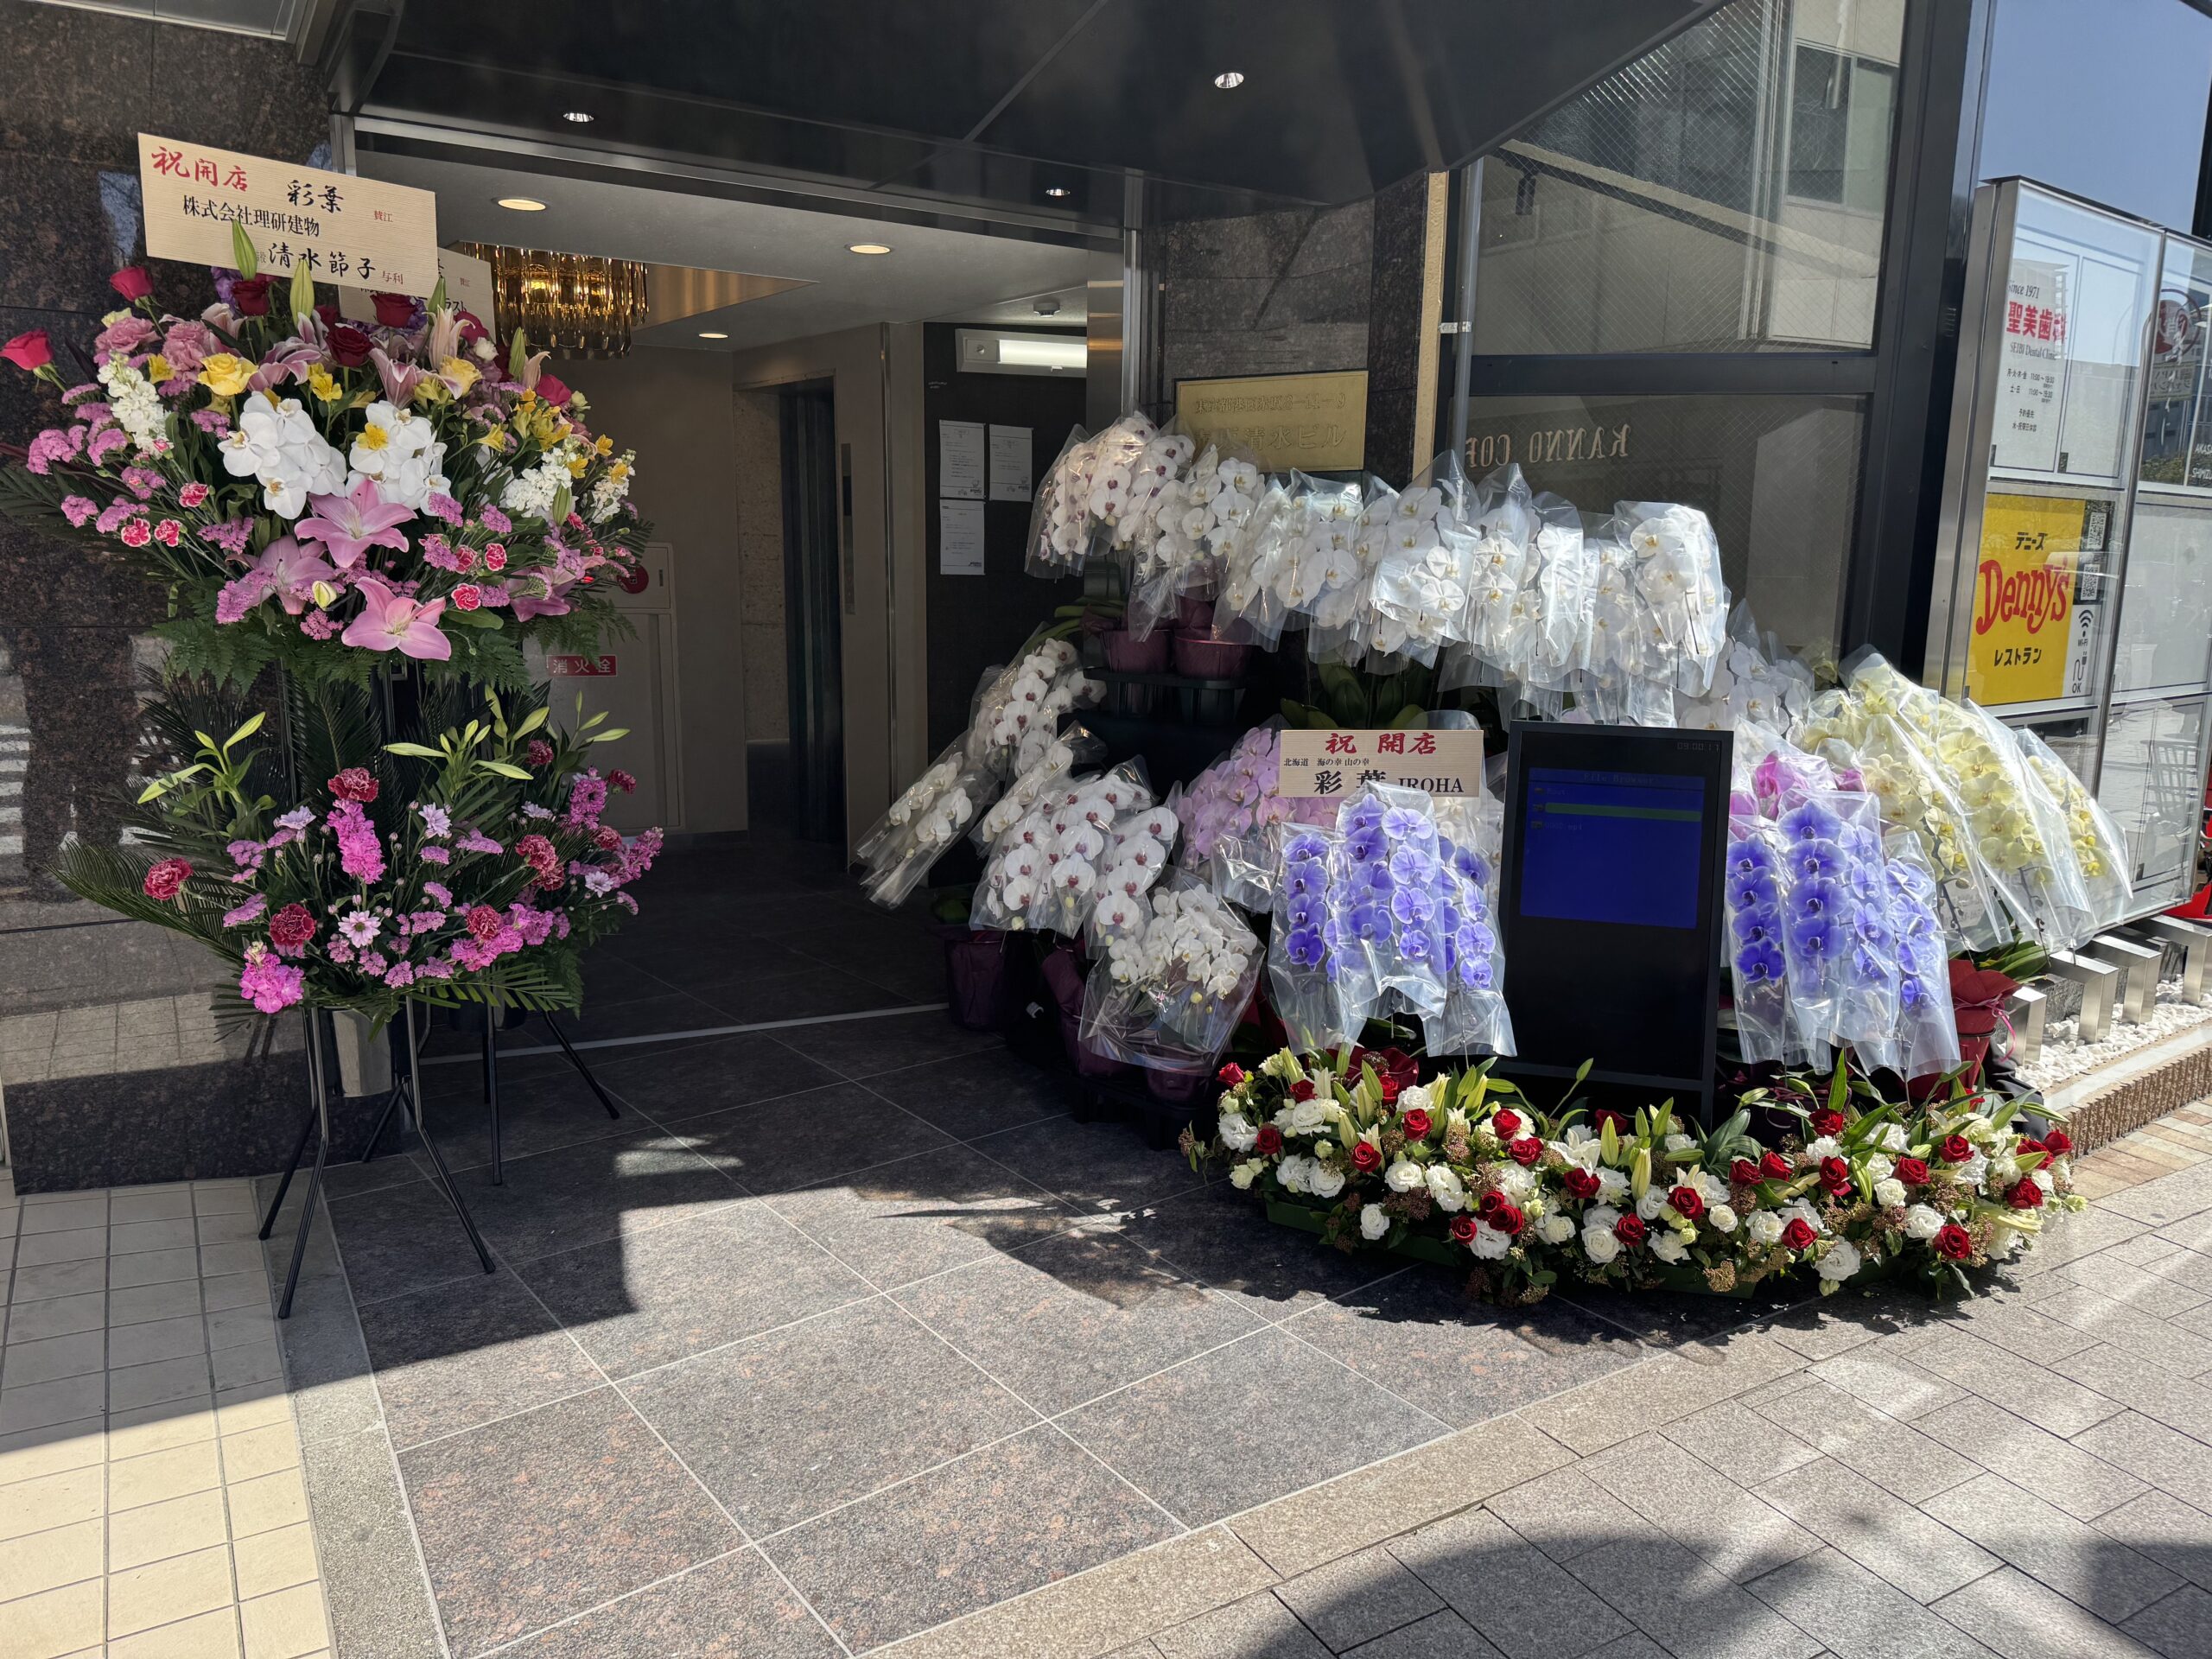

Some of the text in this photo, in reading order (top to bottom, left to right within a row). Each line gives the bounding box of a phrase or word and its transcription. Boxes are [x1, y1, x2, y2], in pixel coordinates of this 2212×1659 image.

[151, 145, 249, 193] 祝開店
[287, 179, 345, 214] 彩葉
[183, 194, 320, 238] 株式会社理研建物
[2025, 285, 2039, 299] 1971
[2025, 345, 2042, 358] Dental
[2014, 532, 2048, 550] デニーズ
[1975, 557, 2070, 635] Denny's
[1993, 647, 2042, 667] レストラン
[2072, 683, 2082, 694] OK
[1283, 758, 1309, 766] 北海道
